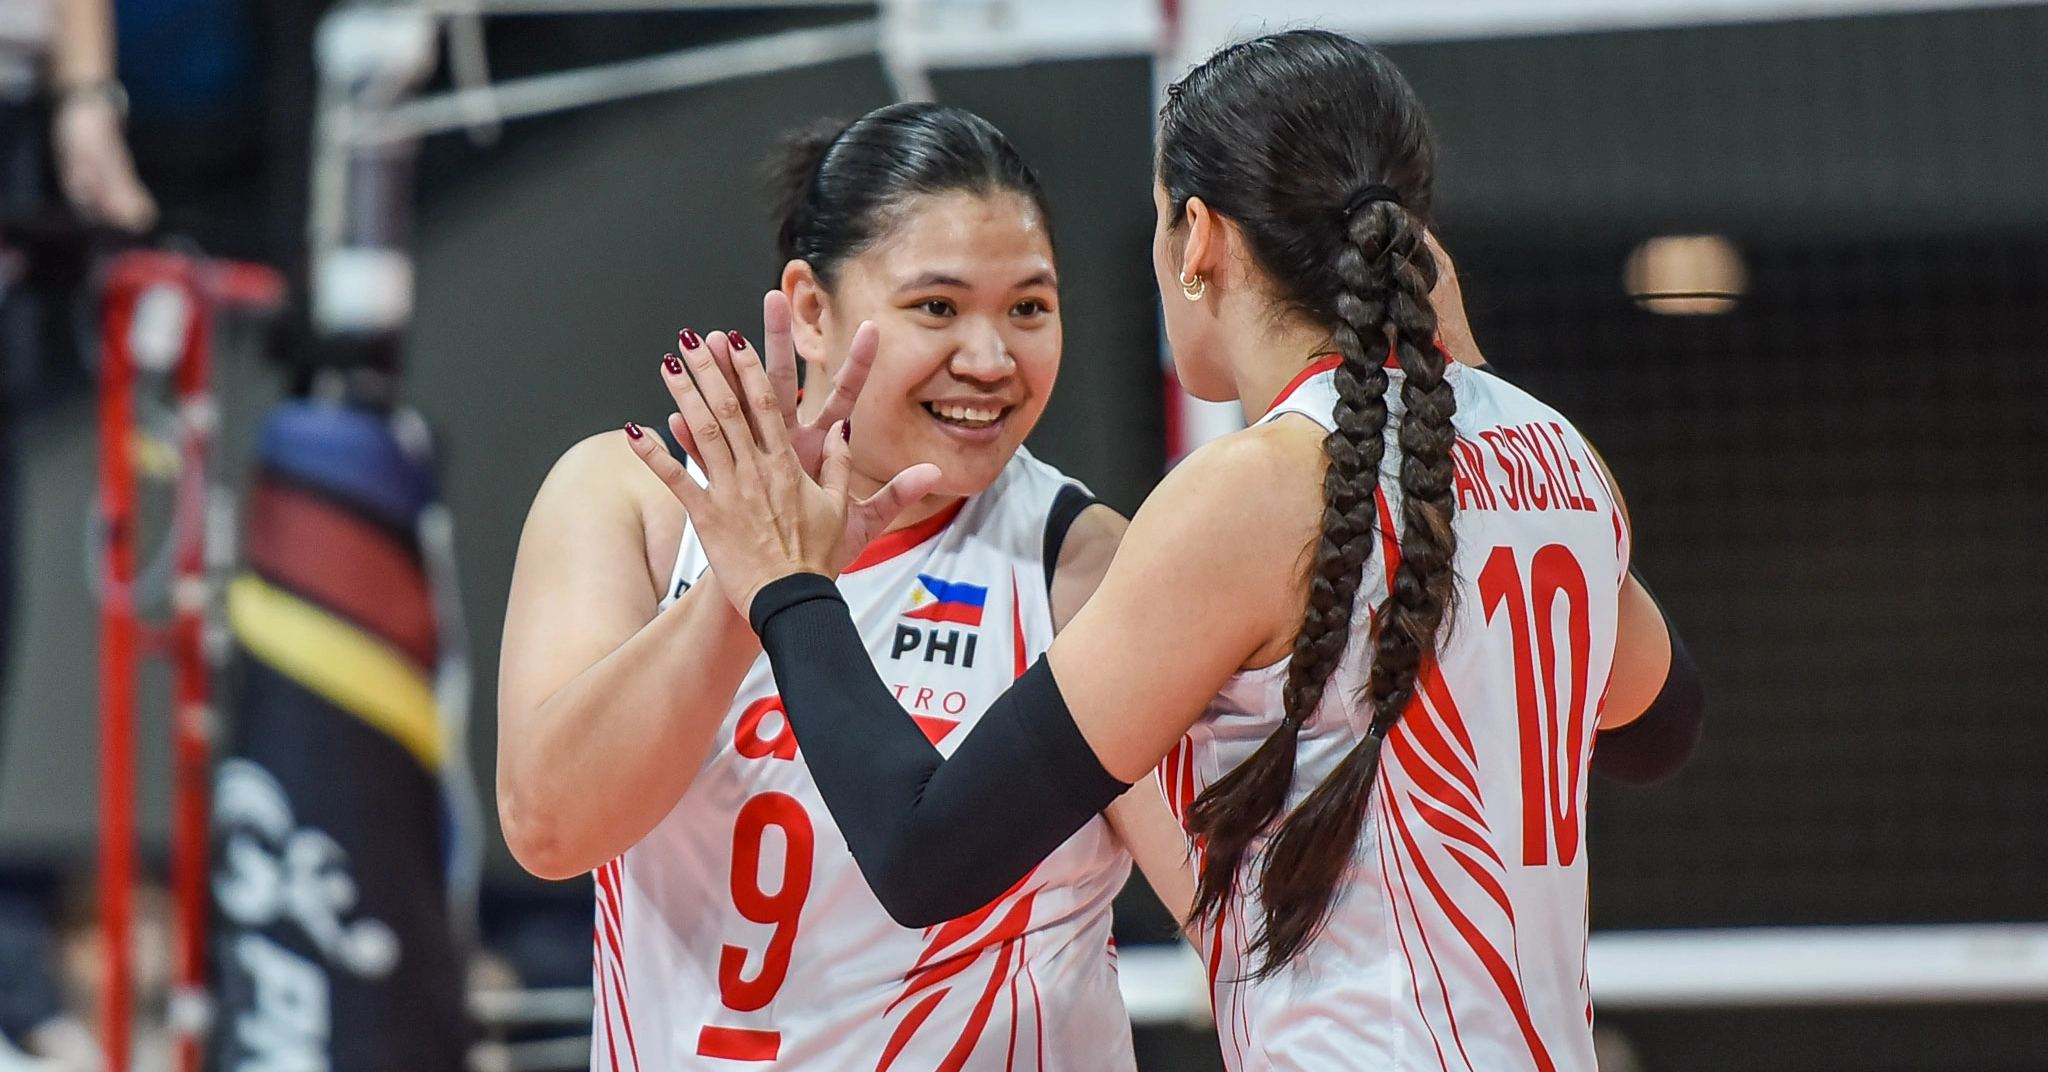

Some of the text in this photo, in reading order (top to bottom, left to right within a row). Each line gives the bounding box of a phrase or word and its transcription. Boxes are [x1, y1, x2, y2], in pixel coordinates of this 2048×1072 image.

[1448, 421, 1598, 513] AN SICKLE
[890, 623, 978, 669] PHI
[893, 684, 967, 715] TRO
[1478, 543, 1591, 867] 10
[718, 791, 815, 1012] 9
